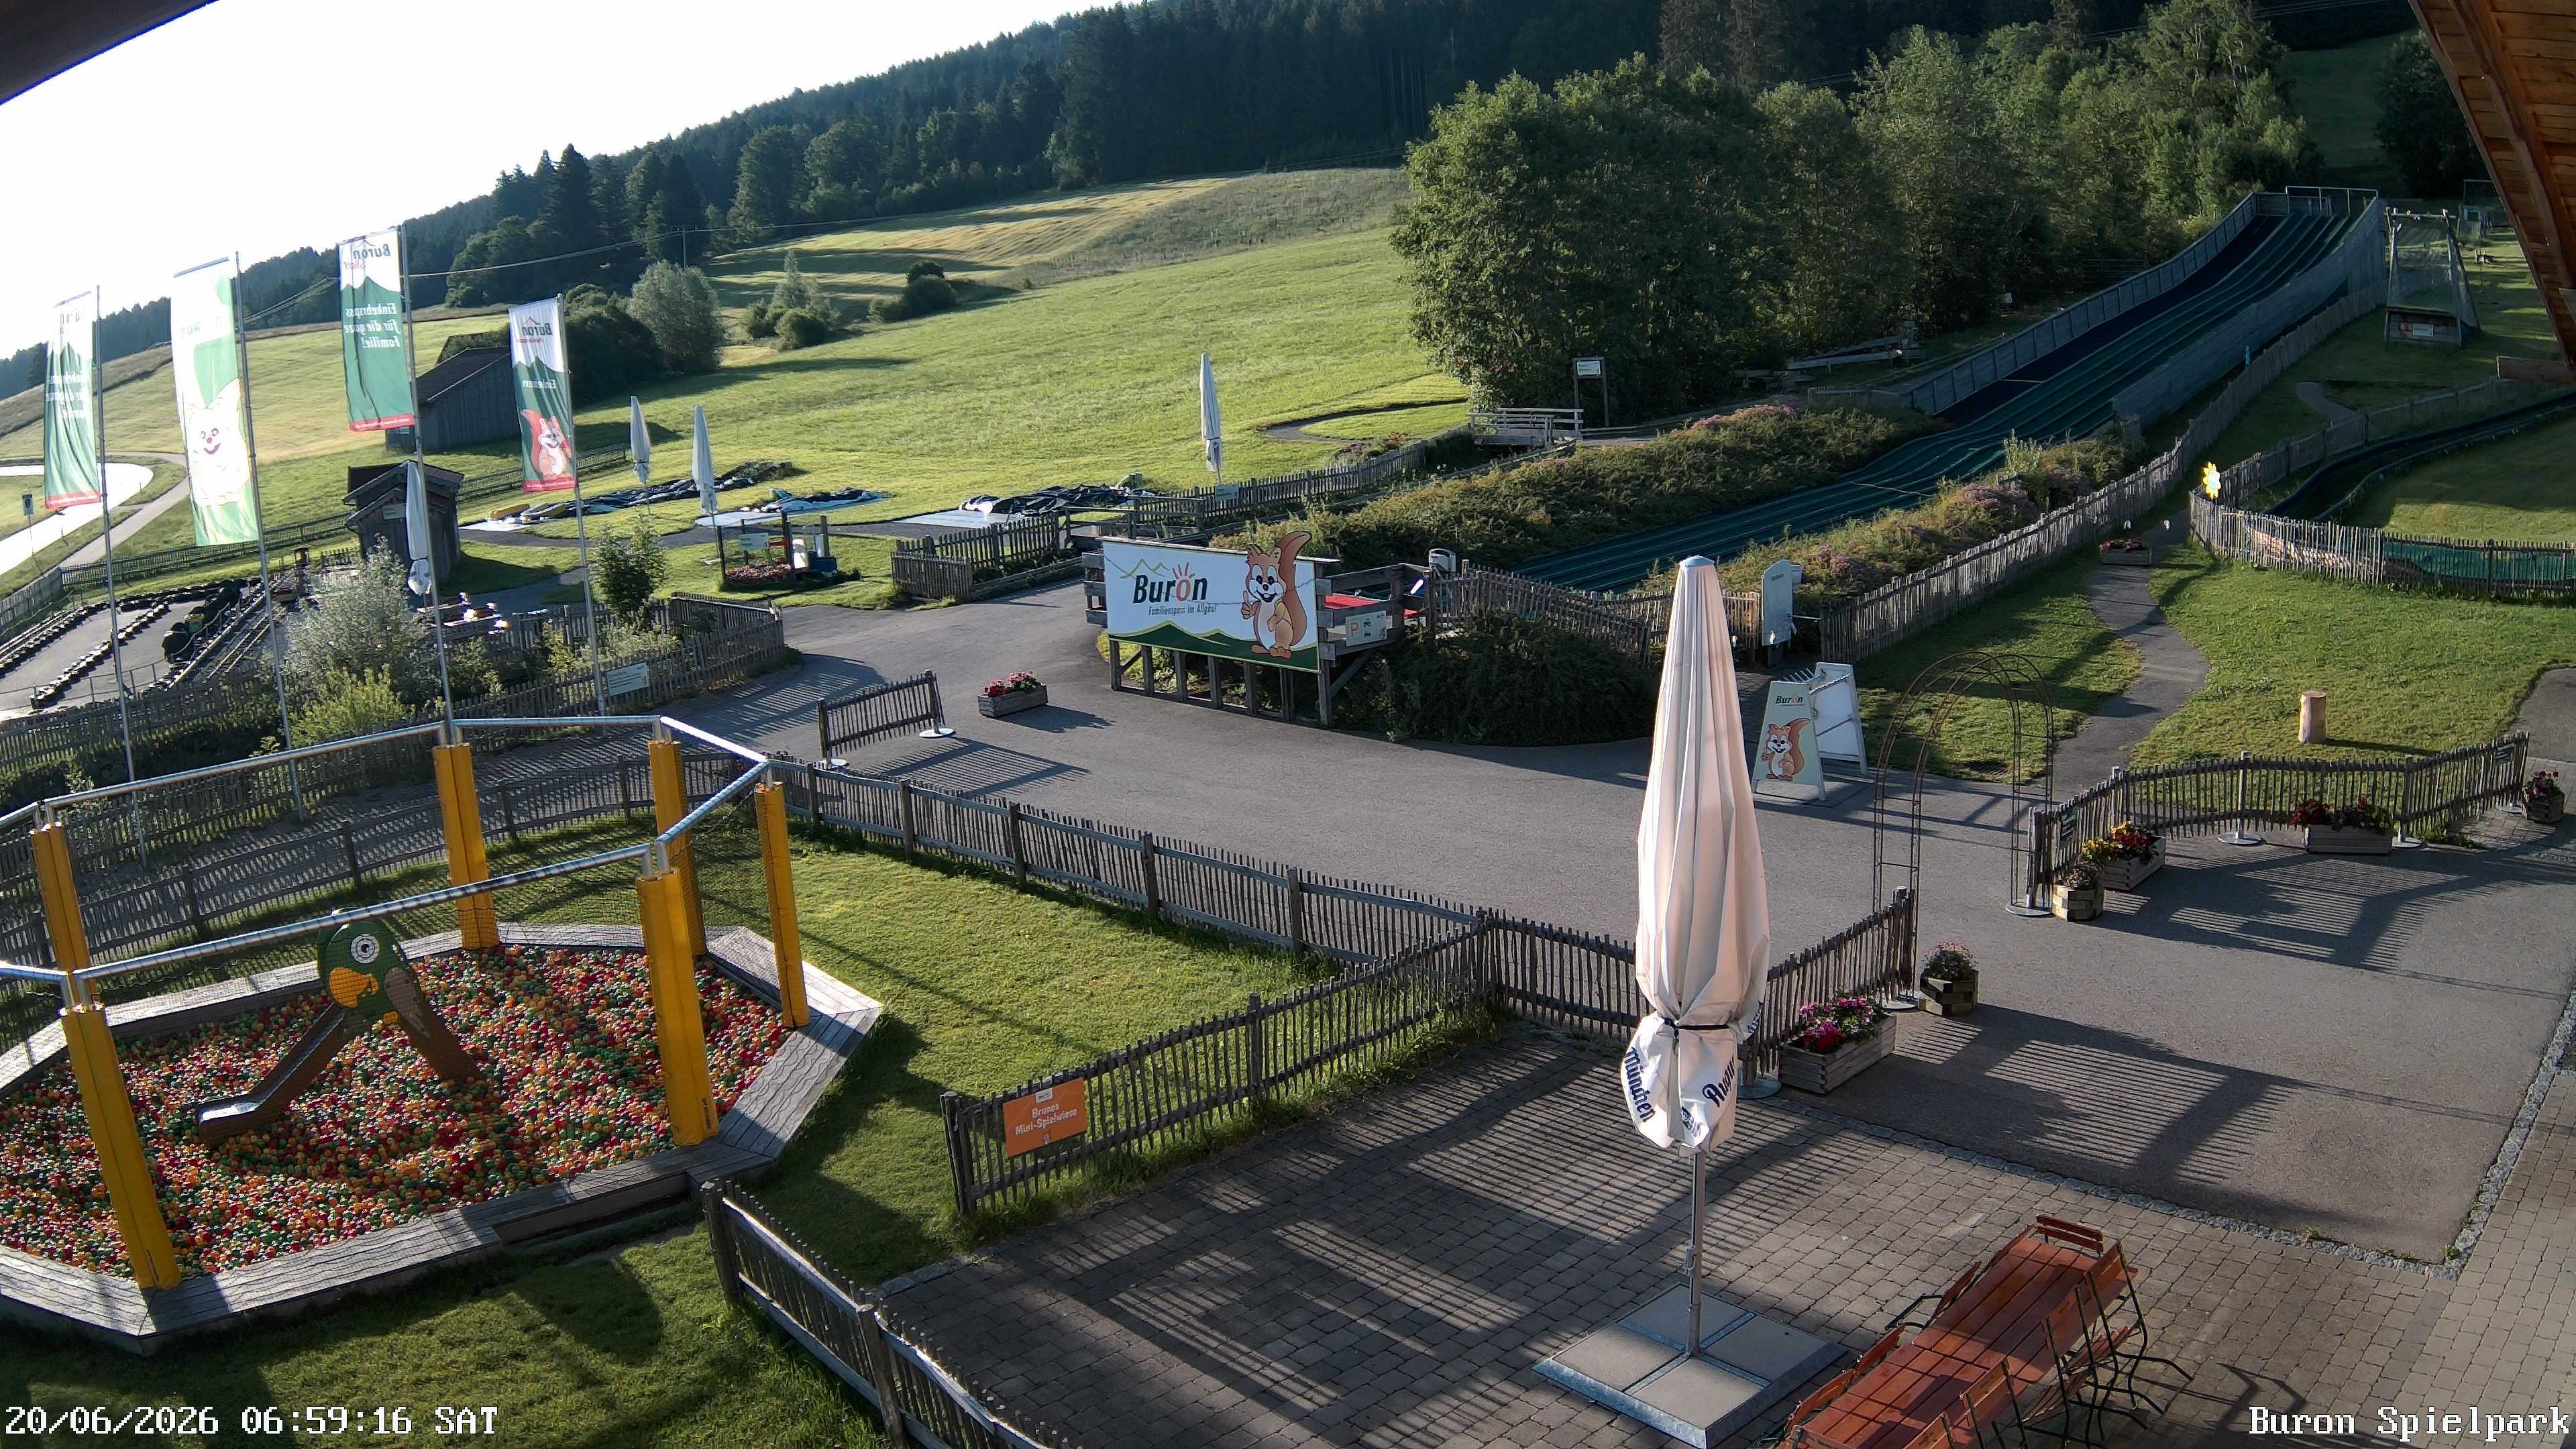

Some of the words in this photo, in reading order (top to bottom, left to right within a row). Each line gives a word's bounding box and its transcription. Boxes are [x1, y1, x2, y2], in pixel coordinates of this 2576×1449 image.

[1132, 574, 1208, 604] Buron
[1187, 605, 1195, 613] im
[1776, 696, 1804, 704] Buron
[1623, 1046, 1656, 1123] München
